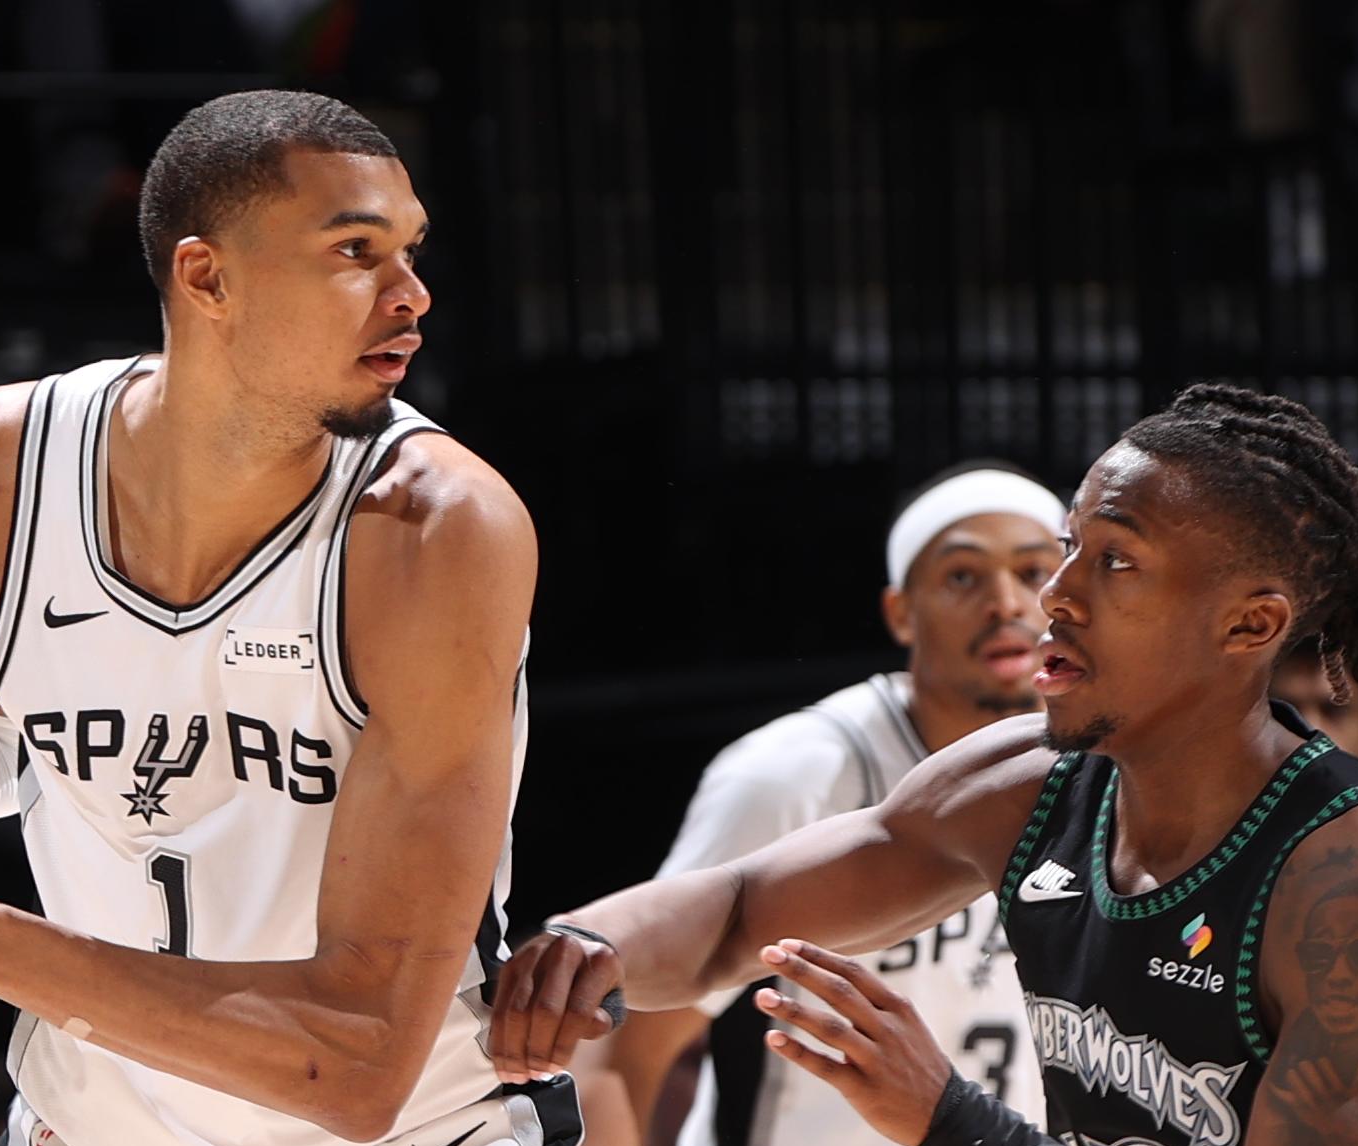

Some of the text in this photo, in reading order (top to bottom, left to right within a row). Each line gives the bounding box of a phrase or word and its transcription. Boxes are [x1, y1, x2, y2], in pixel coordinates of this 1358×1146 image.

[234, 641, 301, 660] LEDGER
[23, 708, 337, 826] SPURS
[145, 846, 194, 959] 1
[1030, 858, 1077, 892] NIKE
[1147, 957, 1225, 993] sezzle
[962, 1024, 1019, 1100] 3
